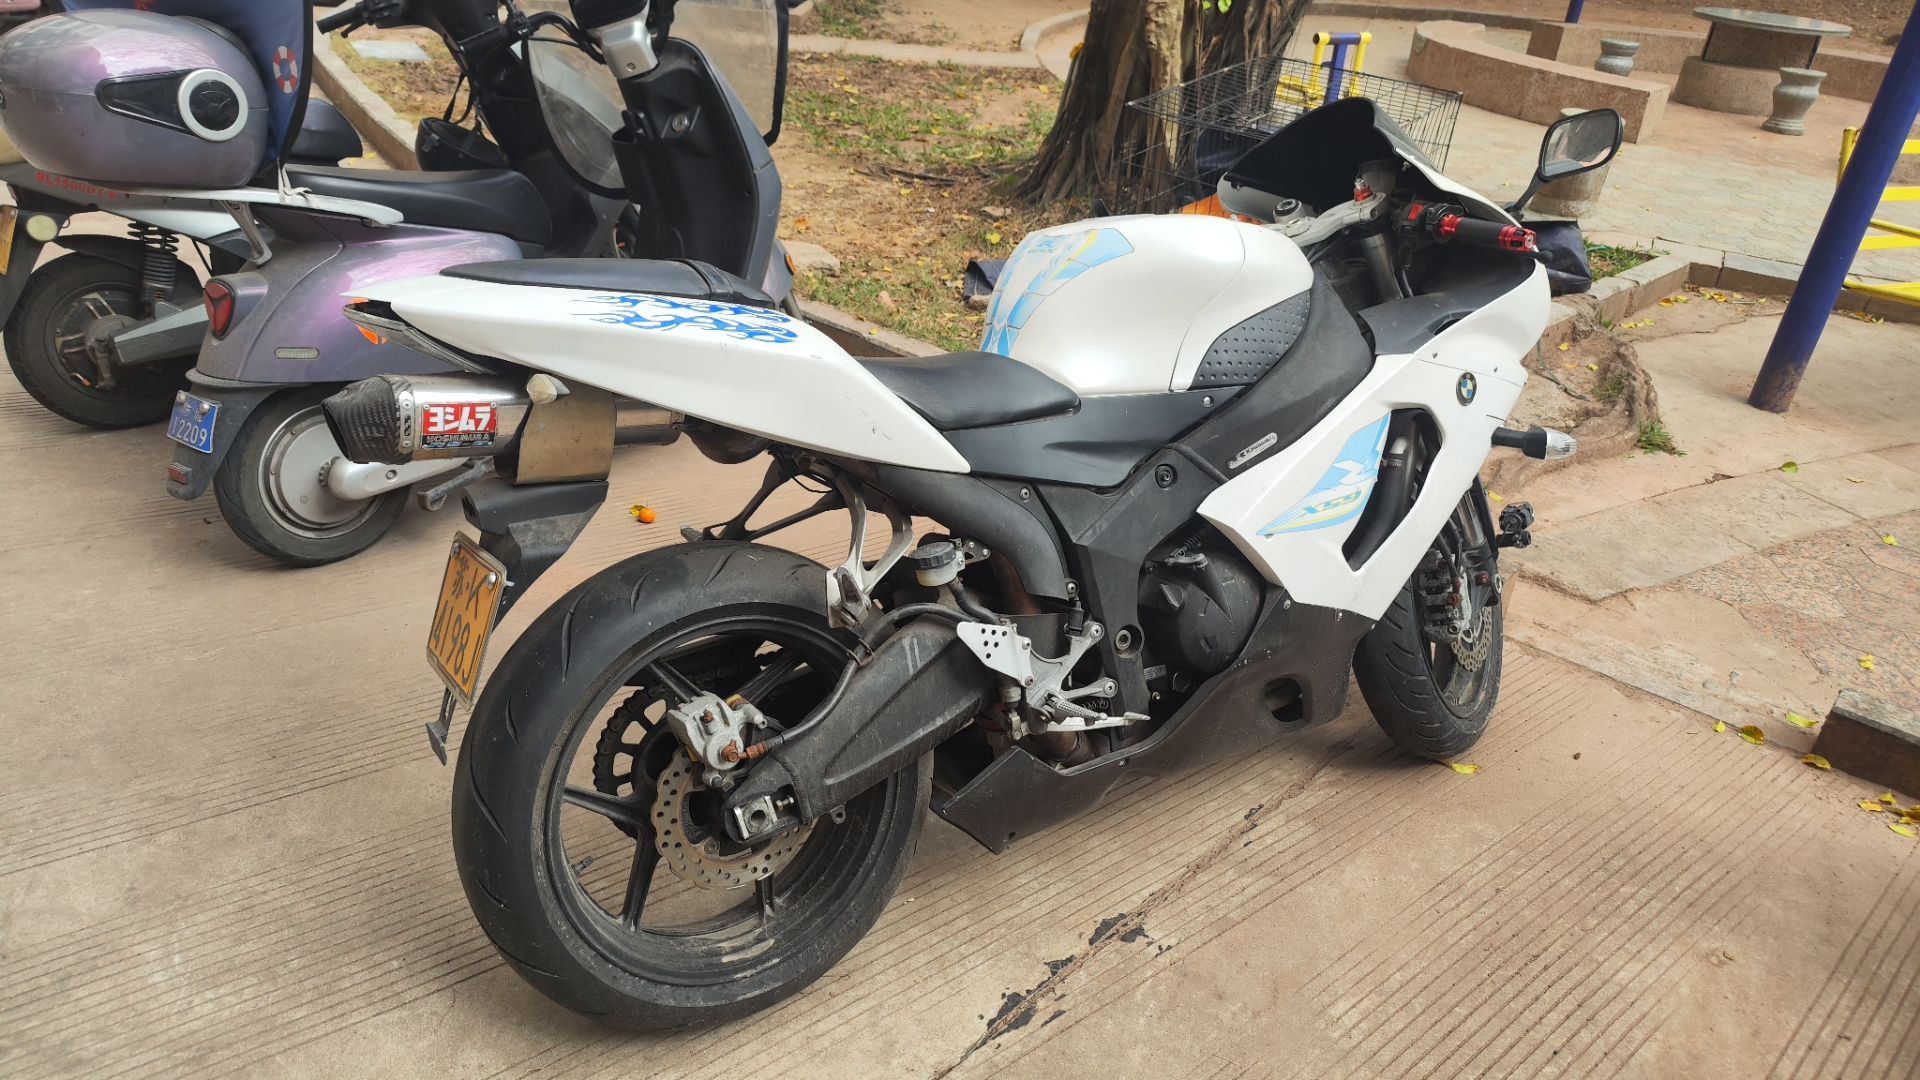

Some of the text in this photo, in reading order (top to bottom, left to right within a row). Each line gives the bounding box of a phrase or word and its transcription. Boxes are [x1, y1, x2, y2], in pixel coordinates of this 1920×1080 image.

[171, 416, 207, 447] 12209
[427, 406, 491, 432] ヨシムラ
[433, 600, 481, 686] 4198J
